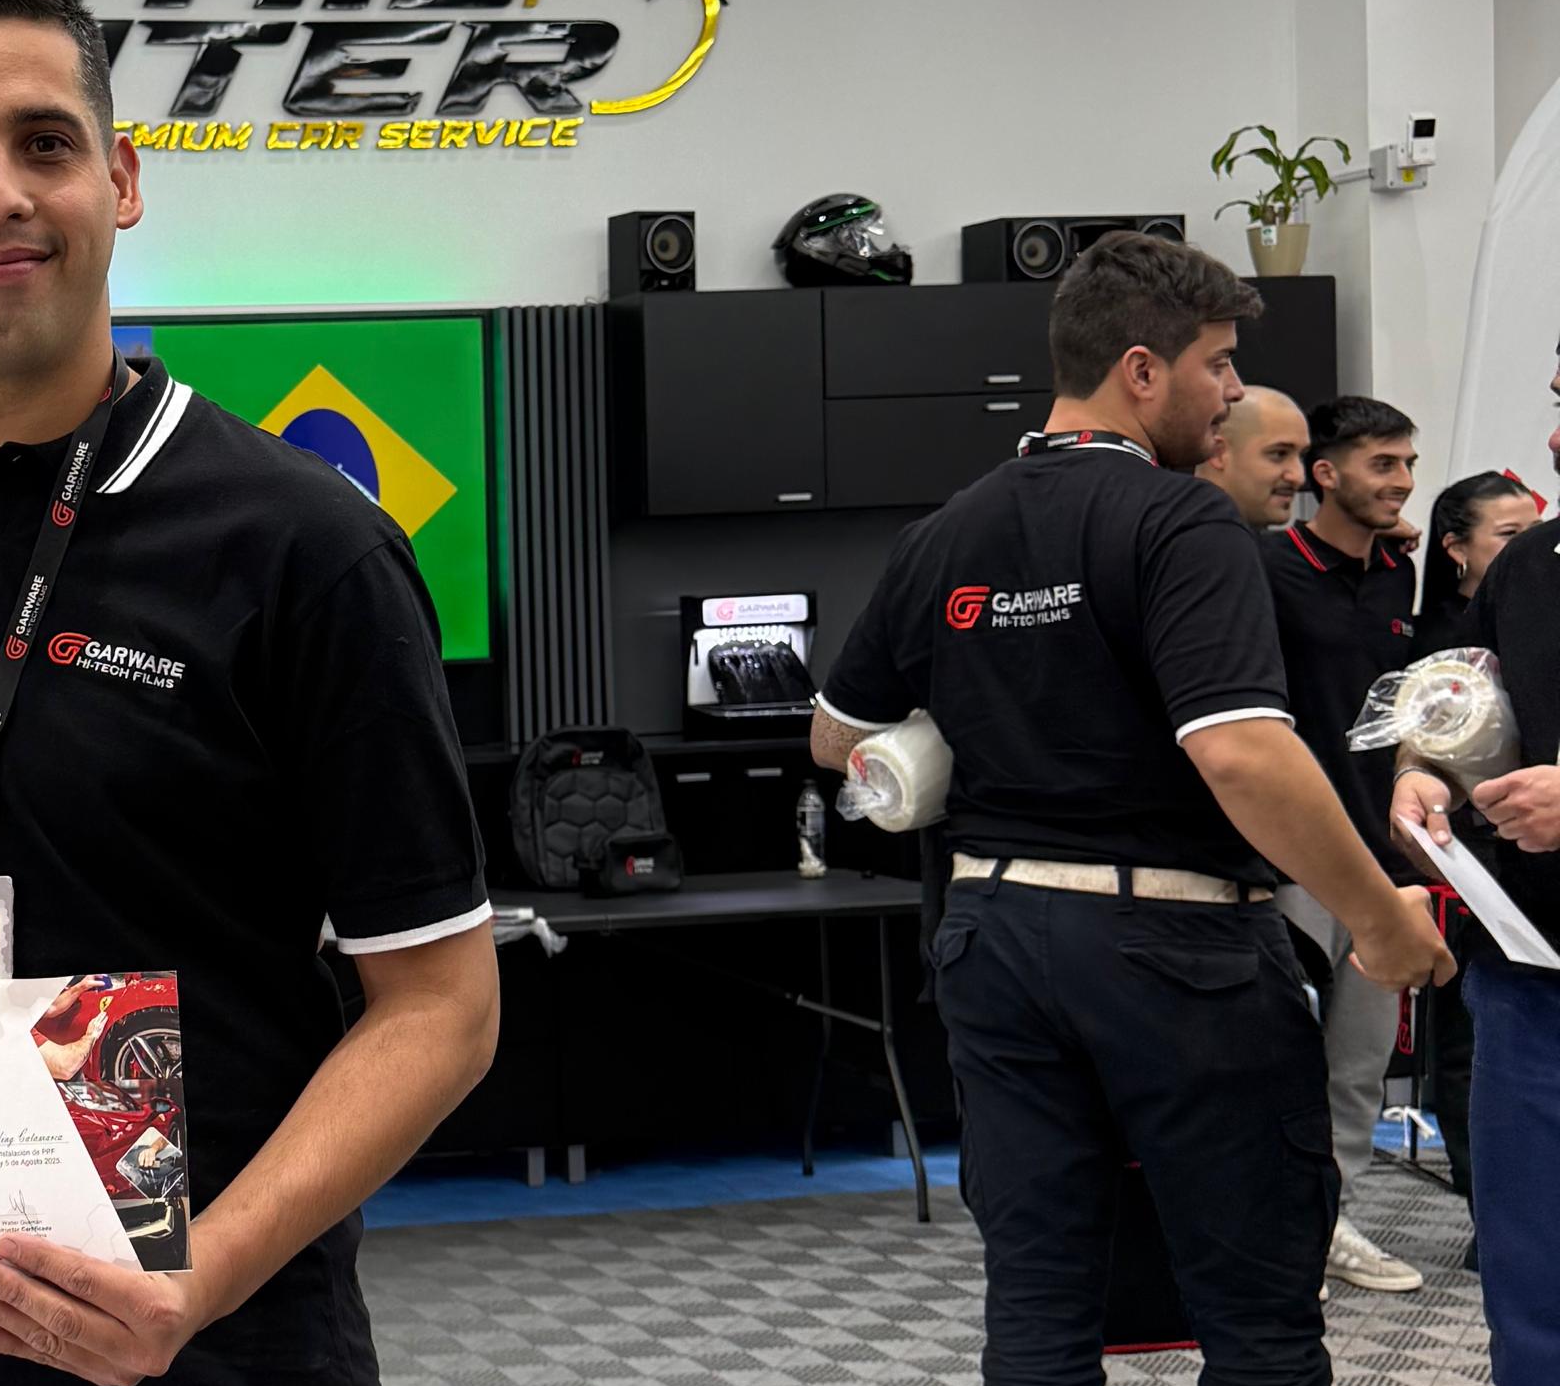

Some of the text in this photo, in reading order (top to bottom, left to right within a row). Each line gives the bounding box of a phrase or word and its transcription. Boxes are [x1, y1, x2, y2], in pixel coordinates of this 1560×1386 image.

[113, 117, 585, 150] MIUM CAR SERVICE
[61, 441, 90, 501] GARWARE
[15, 574, 45, 635] GARWARE
[991, 582, 1083, 614] GARWARE
[75, 655, 176, 690] HI-TECH FILMS
[84, 640, 186, 680] GARWARE
